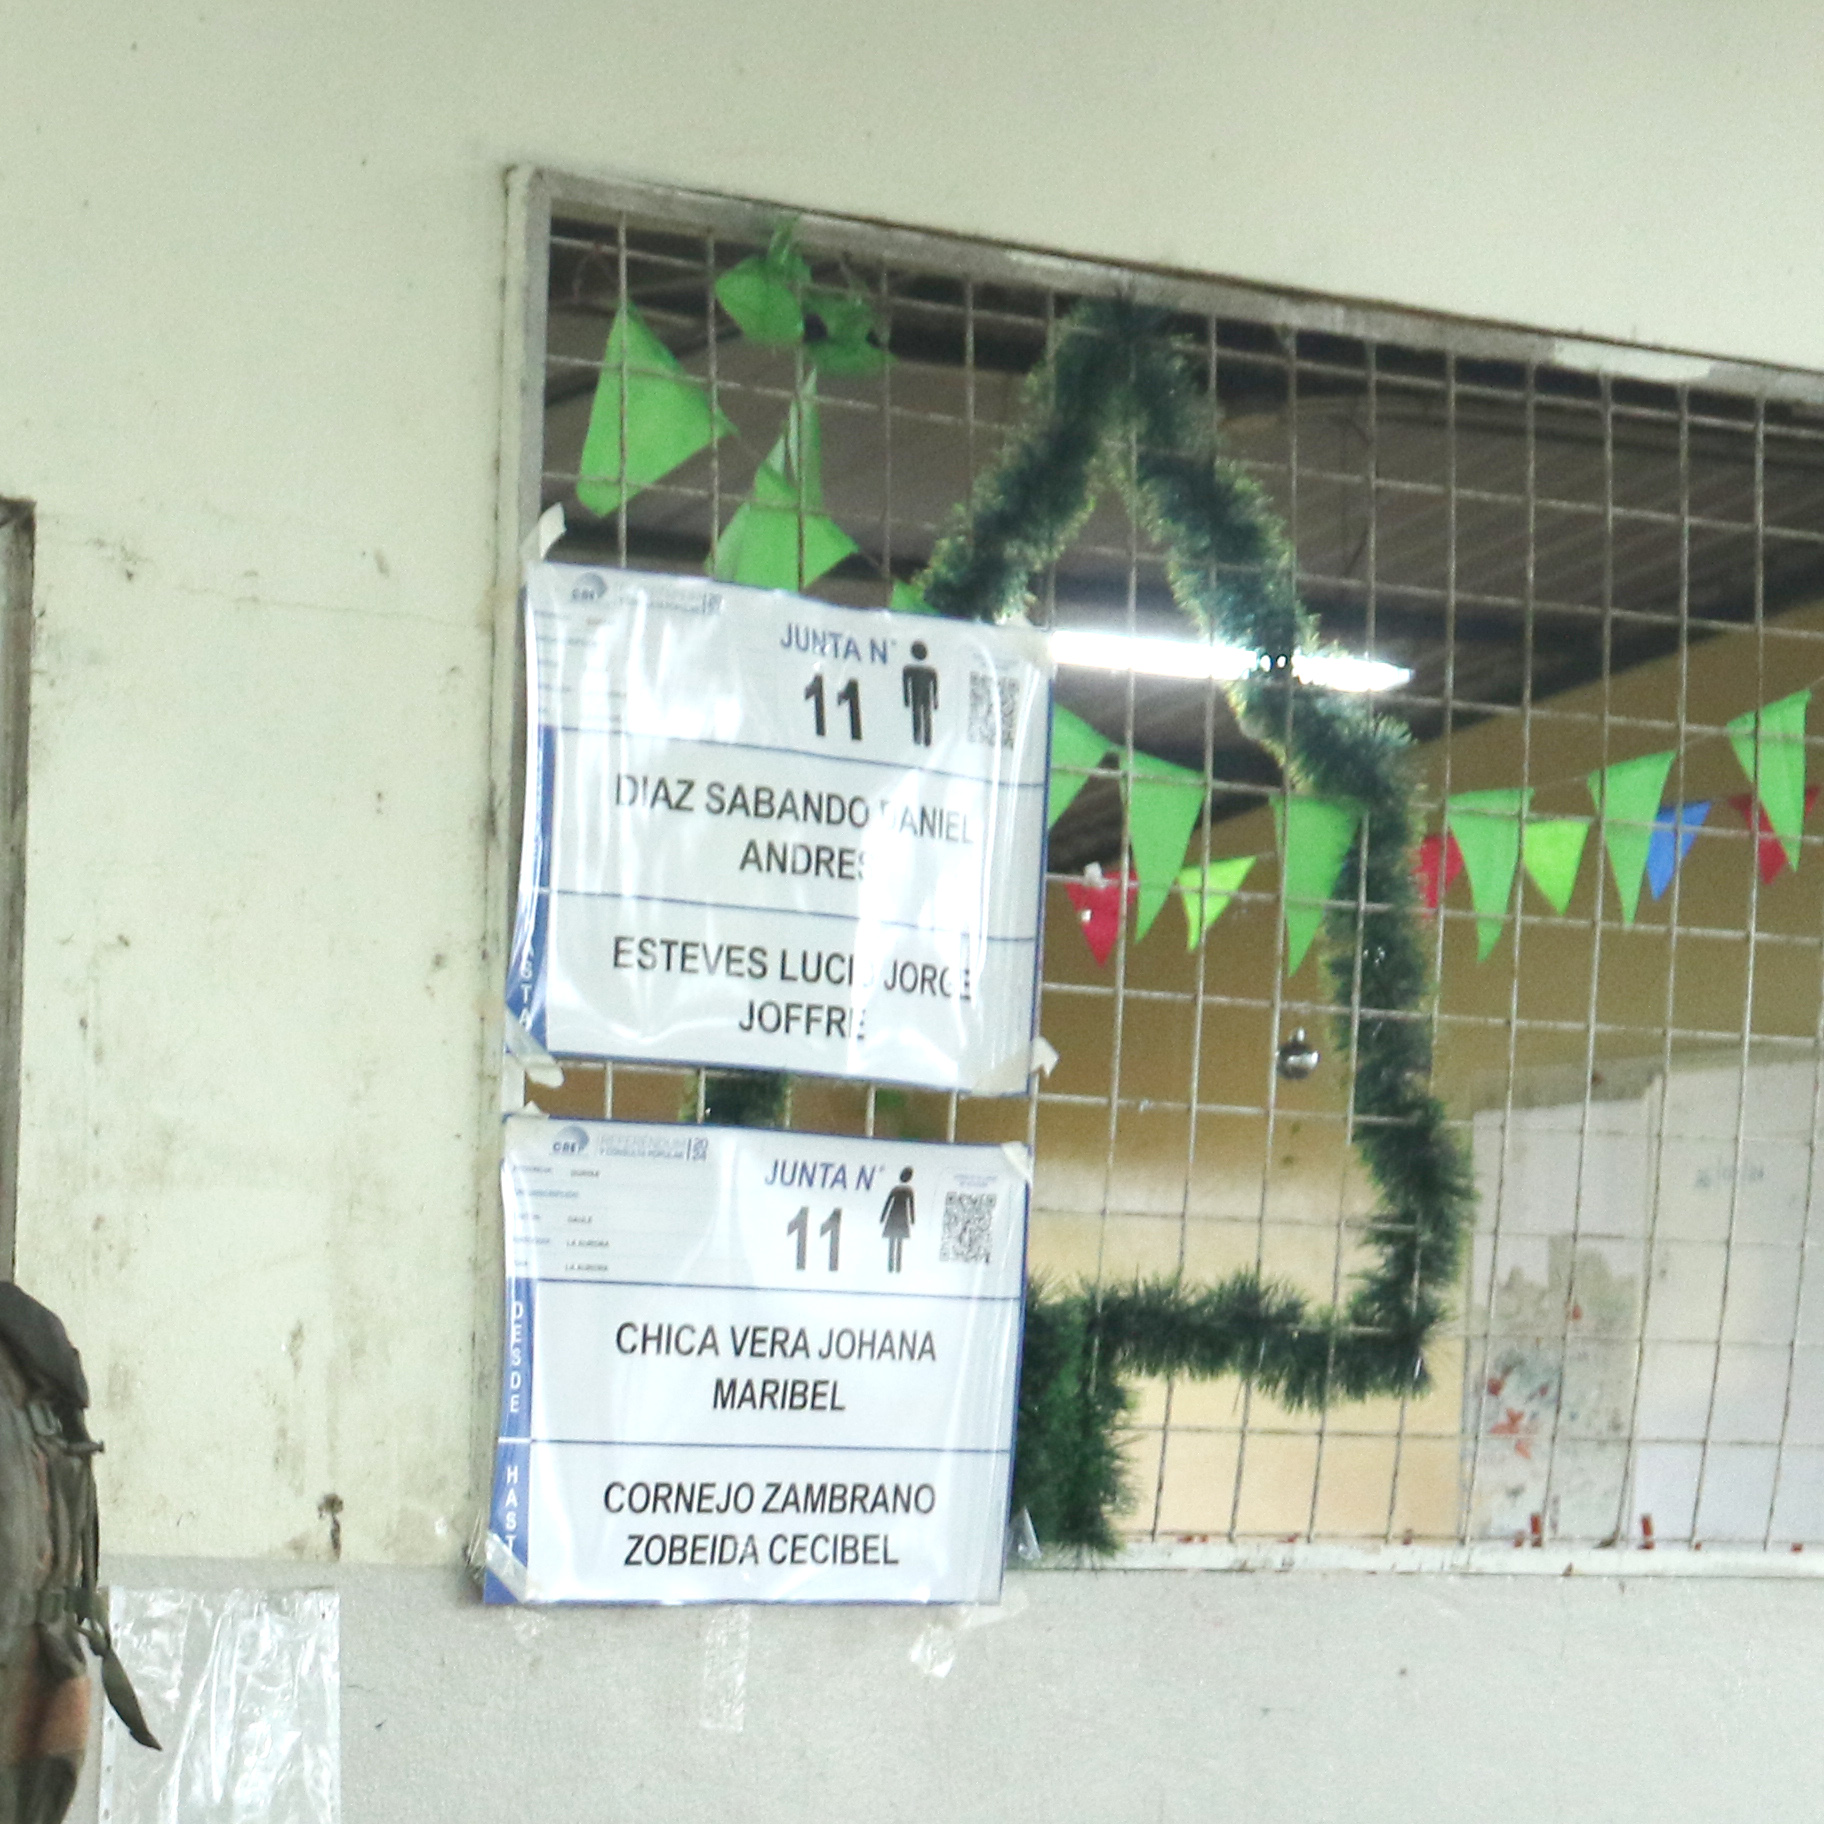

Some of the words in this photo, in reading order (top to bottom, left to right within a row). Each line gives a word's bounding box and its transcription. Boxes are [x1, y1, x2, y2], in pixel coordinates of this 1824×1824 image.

[780, 621, 862, 662] JUNTA
[804, 672, 863, 741] 11
[615, 773, 695, 812] DIAZ
[705, 781, 870, 828] SABANDO
[879, 803, 973, 844] ANIEL
[613, 936, 768, 979] ESTEVES
[780, 949, 873, 988] LUCI
[765, 1160, 847, 1190] JUNTA
[787, 1206, 843, 1271] 11
[510, 1302, 524, 1413] DESDE
[616, 1322, 719, 1356] CHICA
[730, 1326, 810, 1358] VERA
[818, 1327, 936, 1361] JOHANA
[712, 1377, 846, 1411] MARIBEL
[505, 1466, 520, 1556] HAST
[604, 1482, 755, 1513] CORNEJO
[761, 1482, 936, 1514] ZAMBRANO
[624, 1534, 759, 1565] ZOBEIDA
[769, 1534, 899, 1565] CECIBEL
